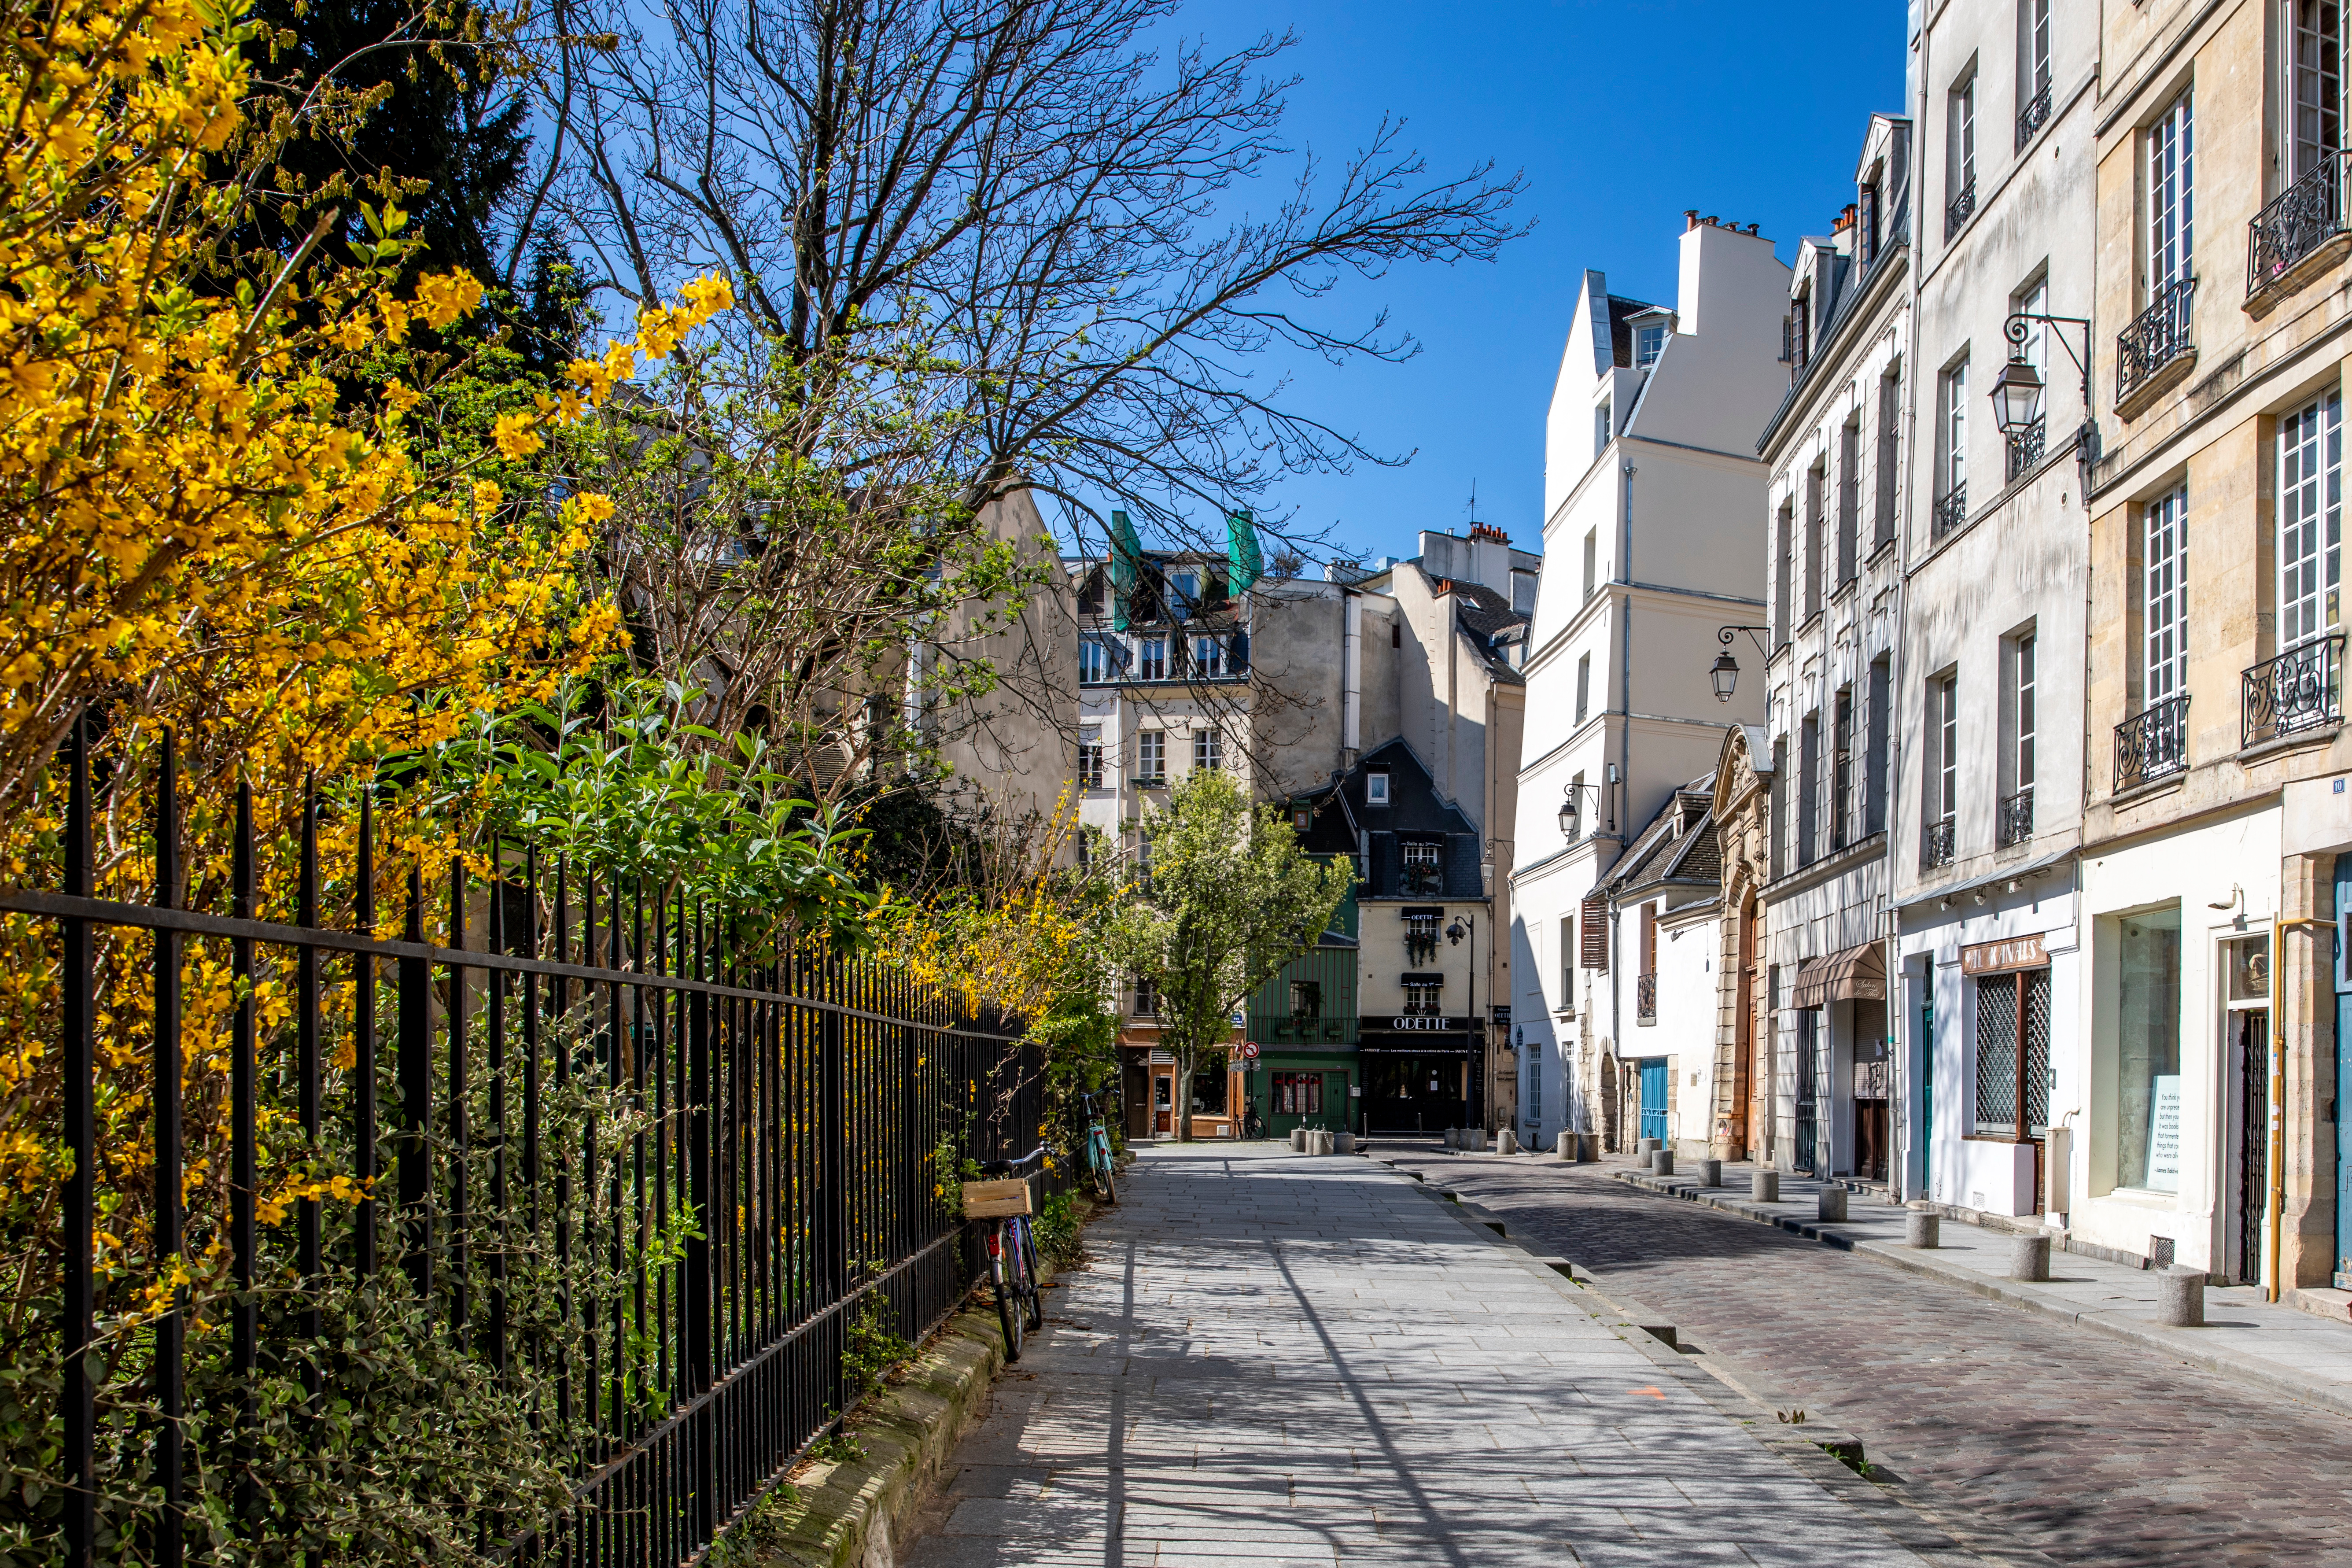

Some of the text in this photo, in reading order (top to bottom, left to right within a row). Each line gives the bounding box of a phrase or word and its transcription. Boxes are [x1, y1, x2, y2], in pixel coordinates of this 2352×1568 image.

[2335, 781, 2342, 792] 10
[1969, 940, 2037, 969] AL KANALS
[1856, 979, 1877, 989] Salon
[1864, 988, 1880, 997] Thé
[1394, 1017, 1450, 1030] ODETTE
[2157, 1141, 2166, 1150] things
